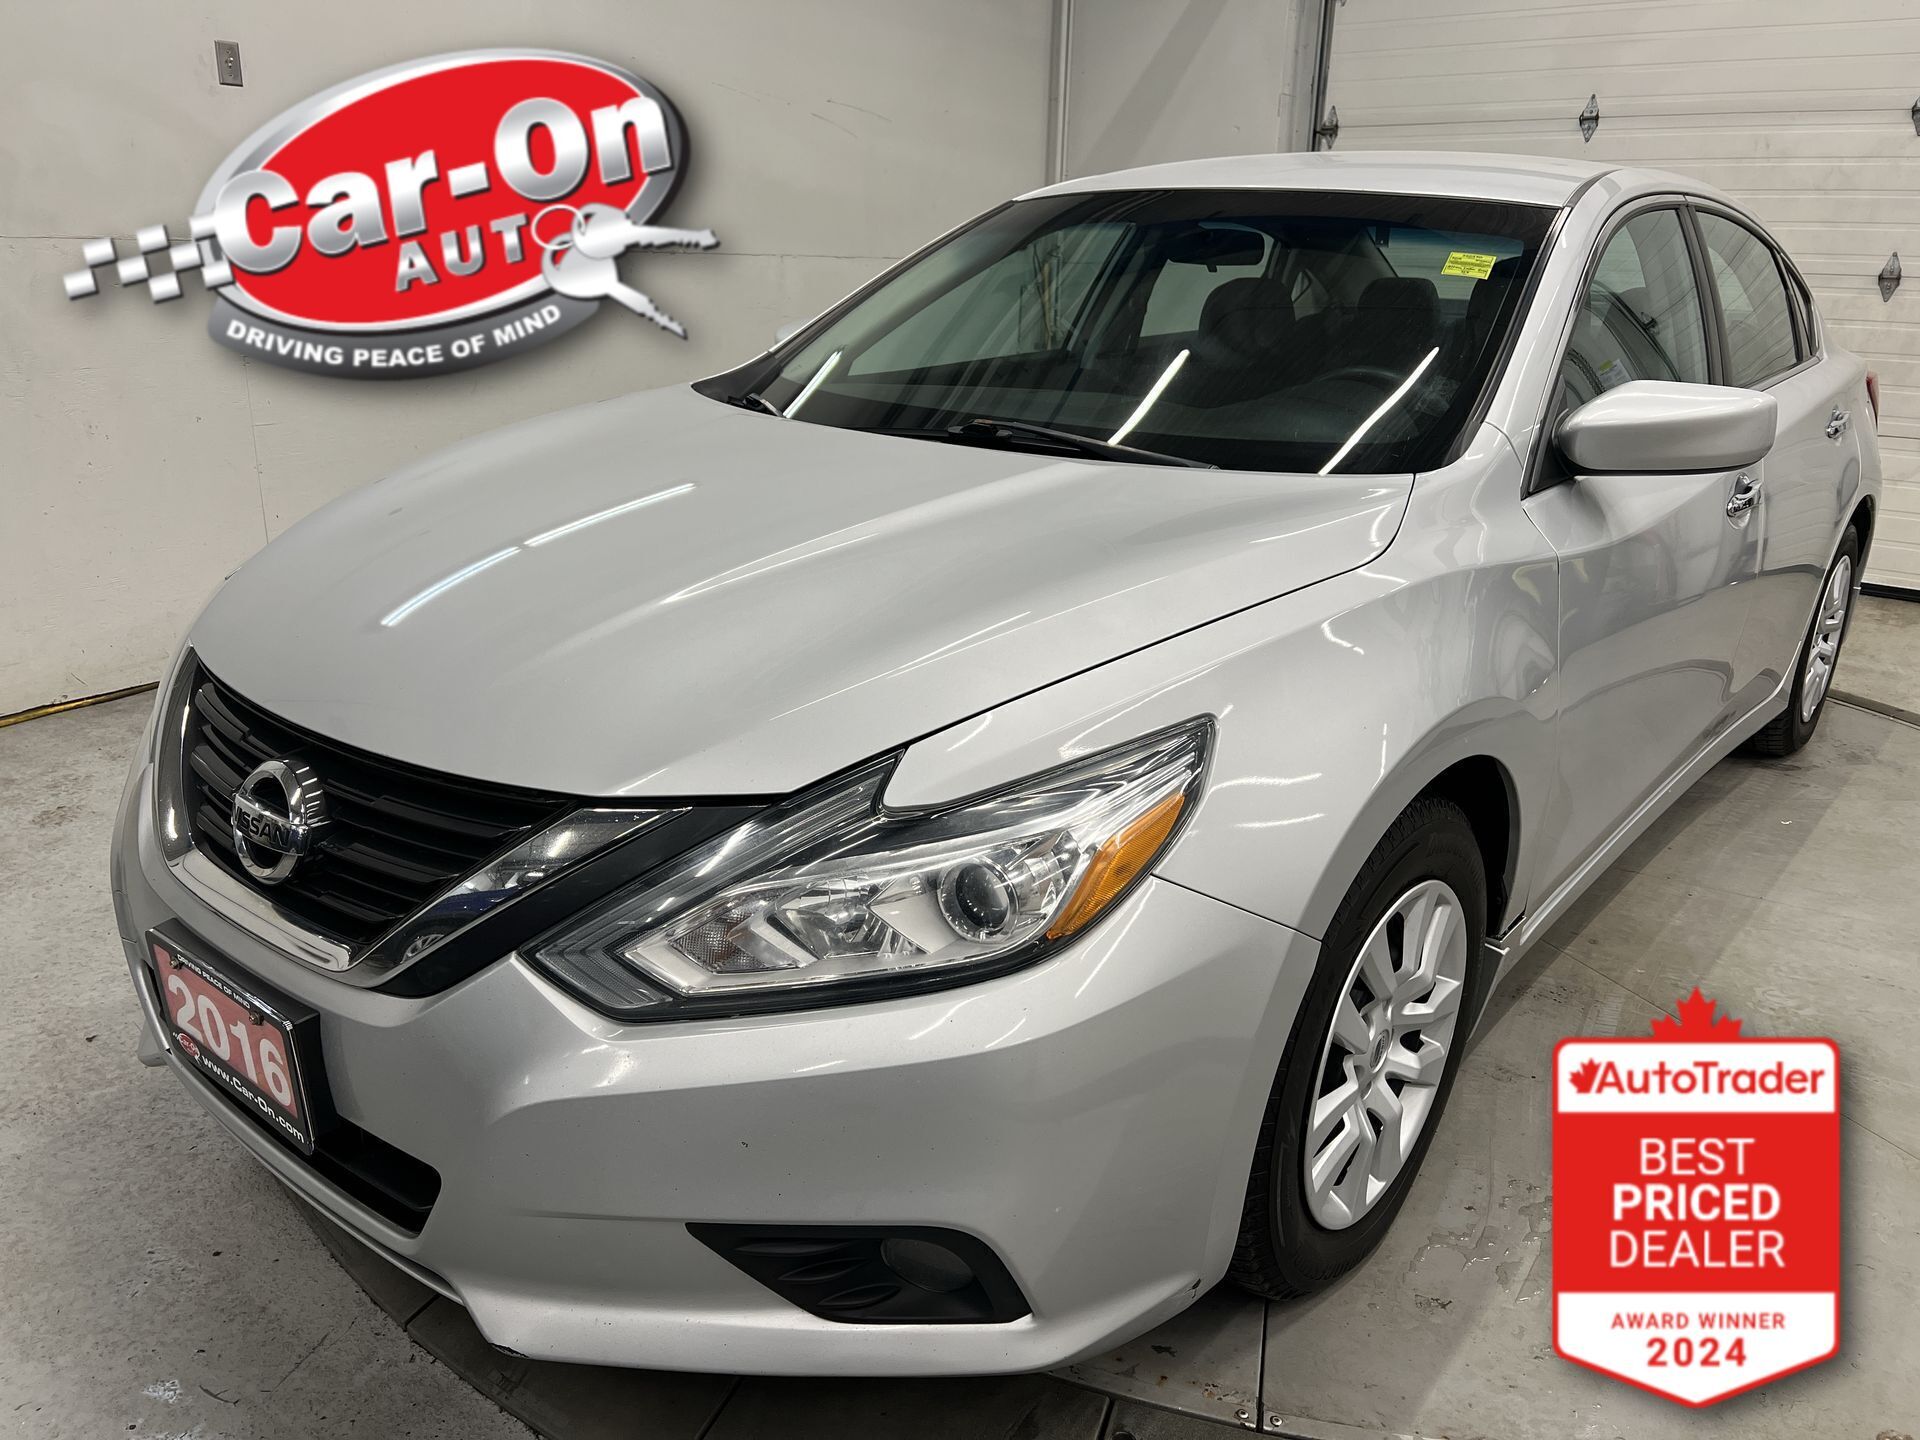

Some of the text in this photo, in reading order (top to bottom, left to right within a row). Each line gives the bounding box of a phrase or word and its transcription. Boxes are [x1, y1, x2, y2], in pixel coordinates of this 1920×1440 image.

[202, 971, 222, 990] PEACE
[233, 992, 251, 1009] MIND
[168, 974, 291, 1107] 2016
